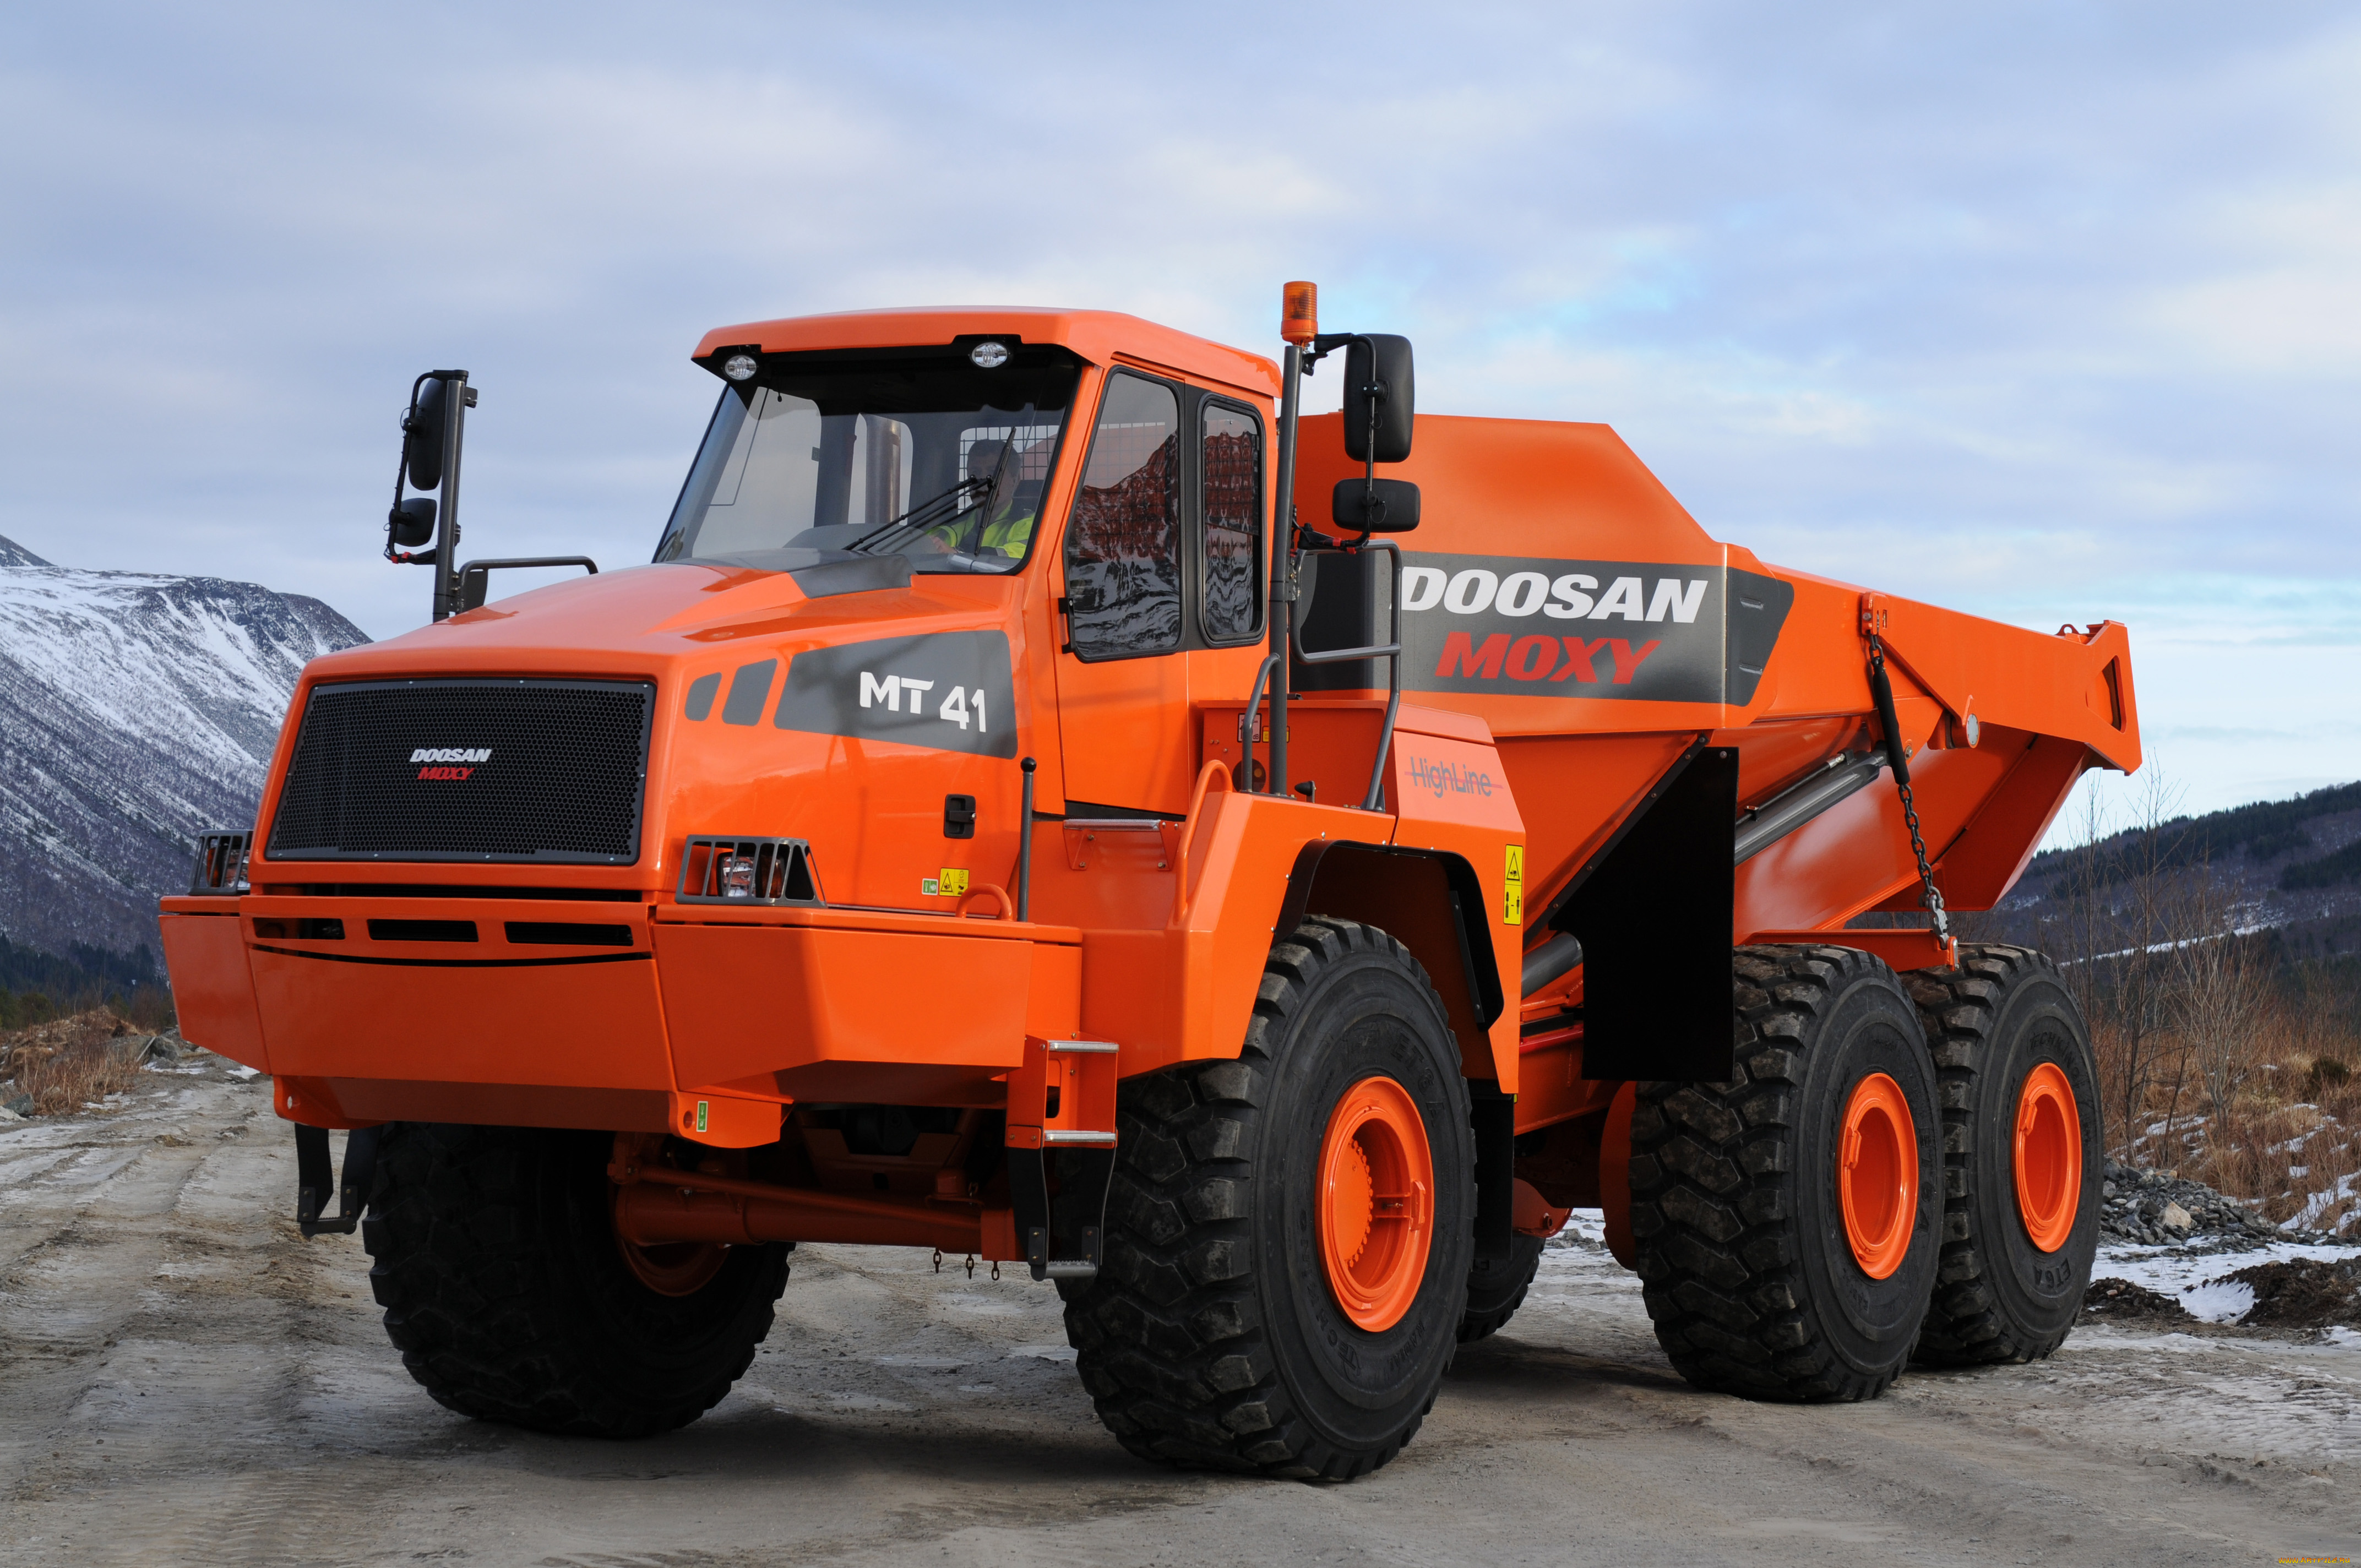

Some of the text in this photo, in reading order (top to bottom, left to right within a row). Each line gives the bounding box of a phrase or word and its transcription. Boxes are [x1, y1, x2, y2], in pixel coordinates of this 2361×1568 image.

[1389, 566, 1709, 623] DOOSAN
[1434, 631, 1661, 684] MOXY
[860, 671, 987, 733] MT 41
[410, 748, 492, 763] DOOSAN
[417, 766, 476, 780] MOXY
[1410, 756, 1492, 798] HighLine
